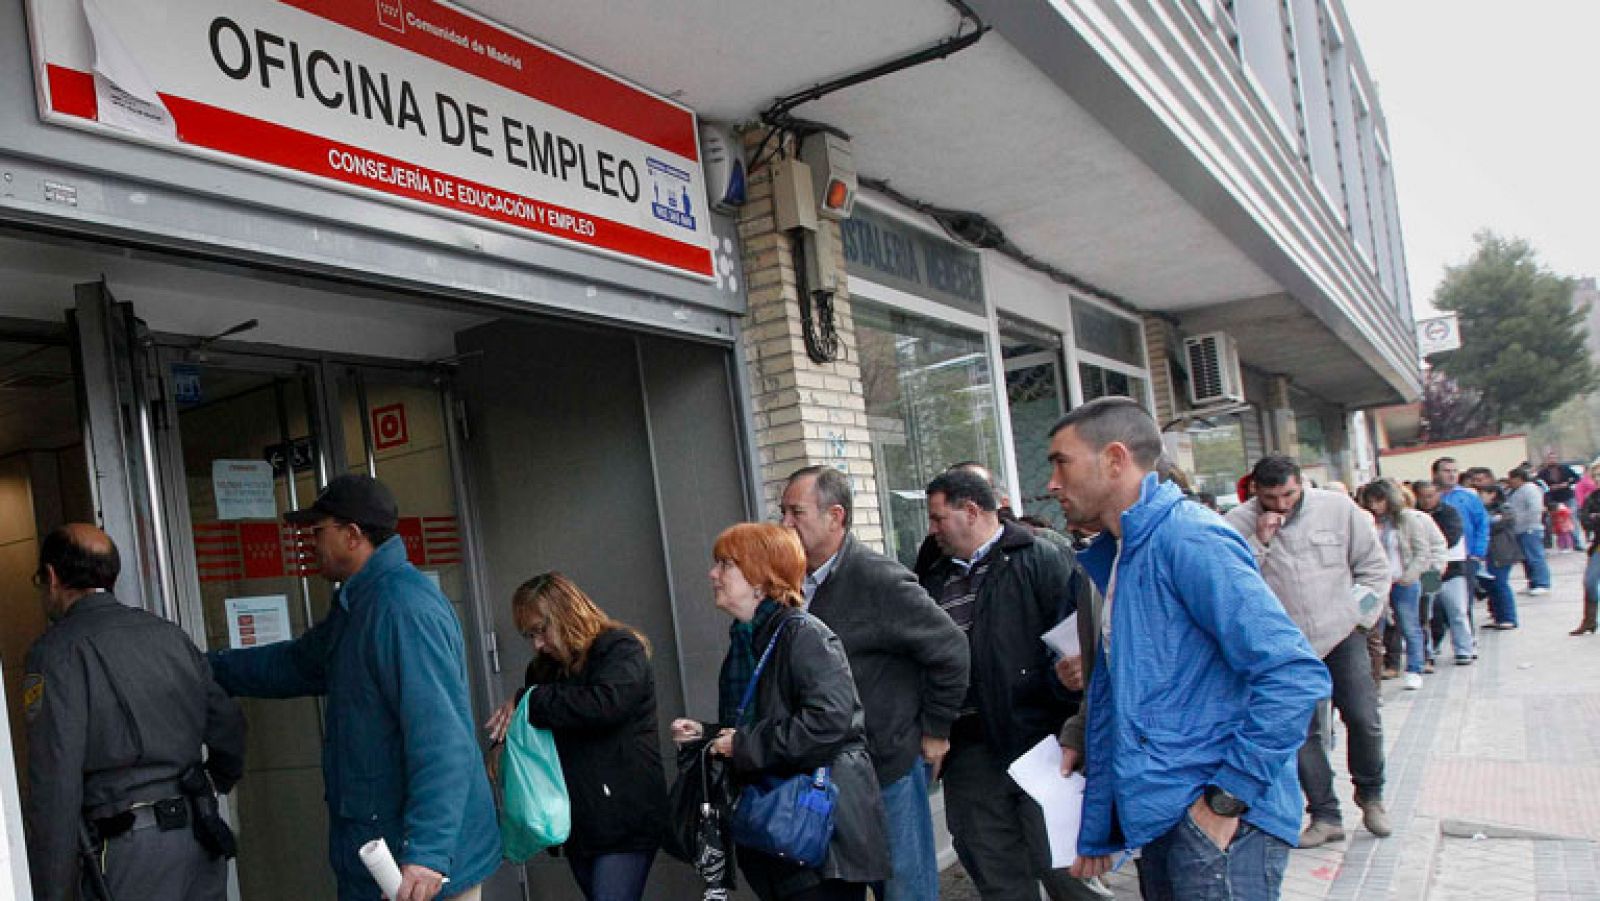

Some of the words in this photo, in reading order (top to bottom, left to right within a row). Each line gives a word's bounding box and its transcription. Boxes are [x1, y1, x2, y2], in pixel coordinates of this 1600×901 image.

[406, 12, 469, 48] Comunidad
[471, 39, 485, 55] de
[487, 45, 522, 70] Madrid
[208, 16, 426, 136] OFICINA
[435, 93, 494, 156] DE
[502, 116, 640, 203] EMPLEO
[328, 149, 431, 195] CONSEJERÍA
[434, 177, 455, 200] DE
[459, 186, 536, 222] EDUCACIÓN
[537, 207, 546, 224] Y
[548, 210, 595, 237] EMPLEO
